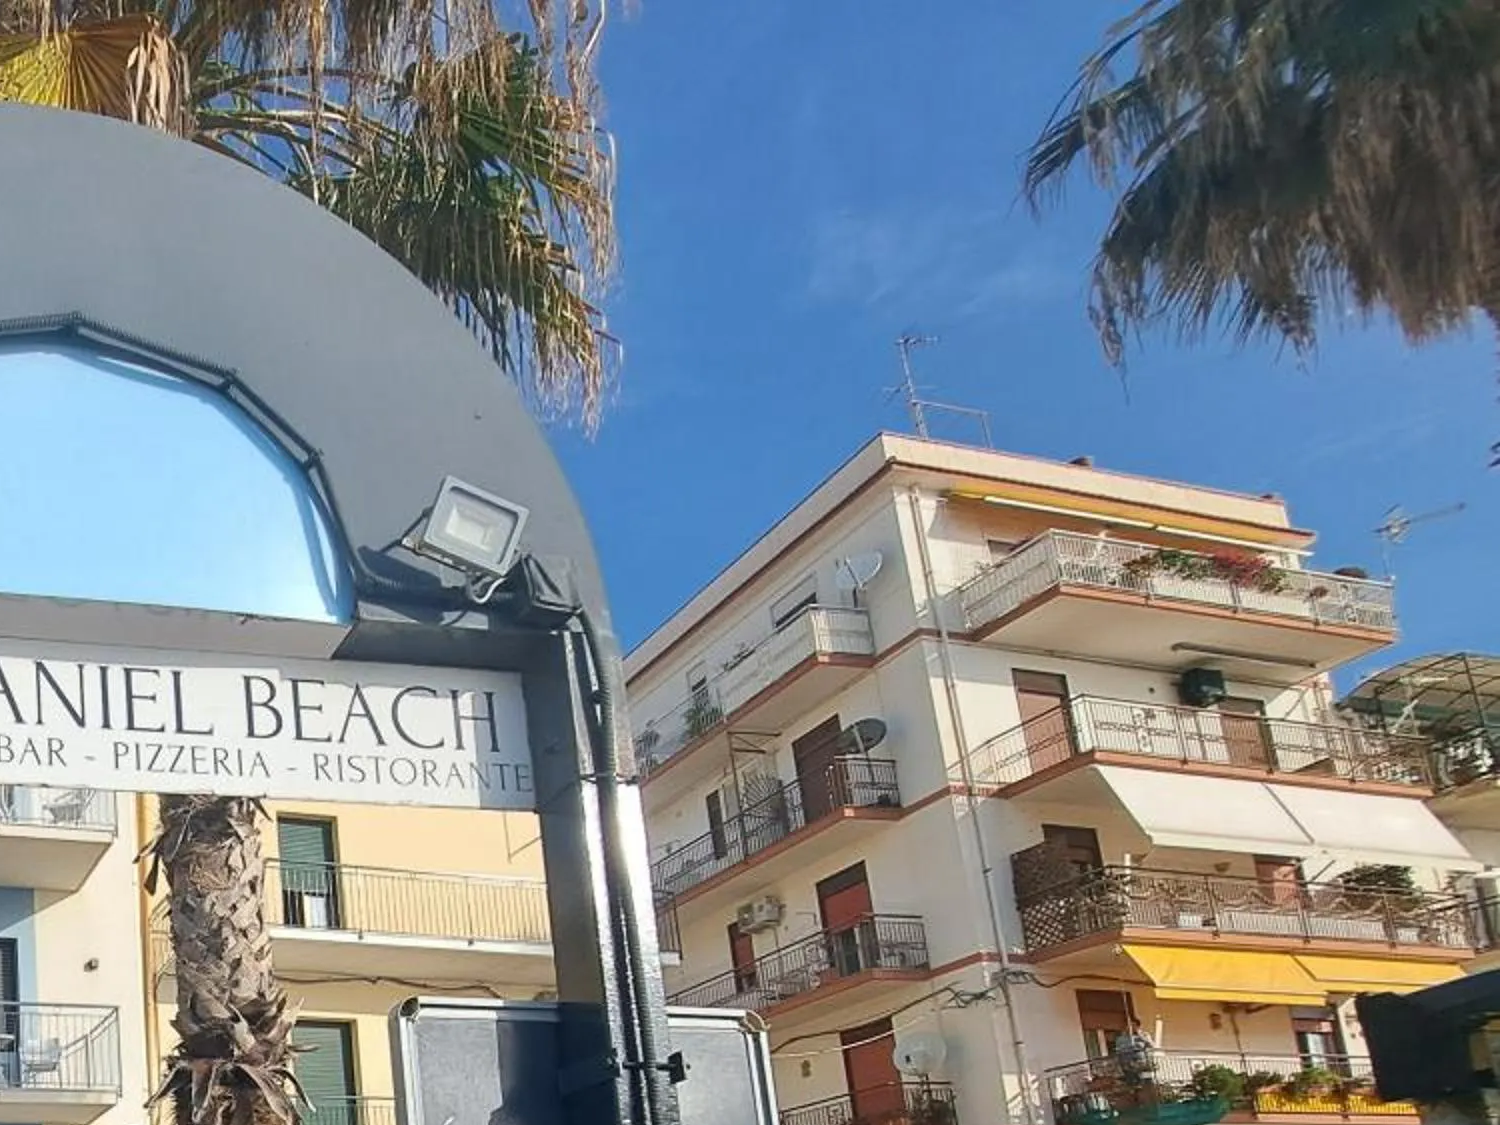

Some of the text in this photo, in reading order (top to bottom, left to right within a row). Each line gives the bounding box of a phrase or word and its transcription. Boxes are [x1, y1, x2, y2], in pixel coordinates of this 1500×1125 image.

[242, 674, 500, 753] BEACH
[113, 740, 271, 778] PIZZERIA
[312, 752, 534, 792] RISTORANTE
